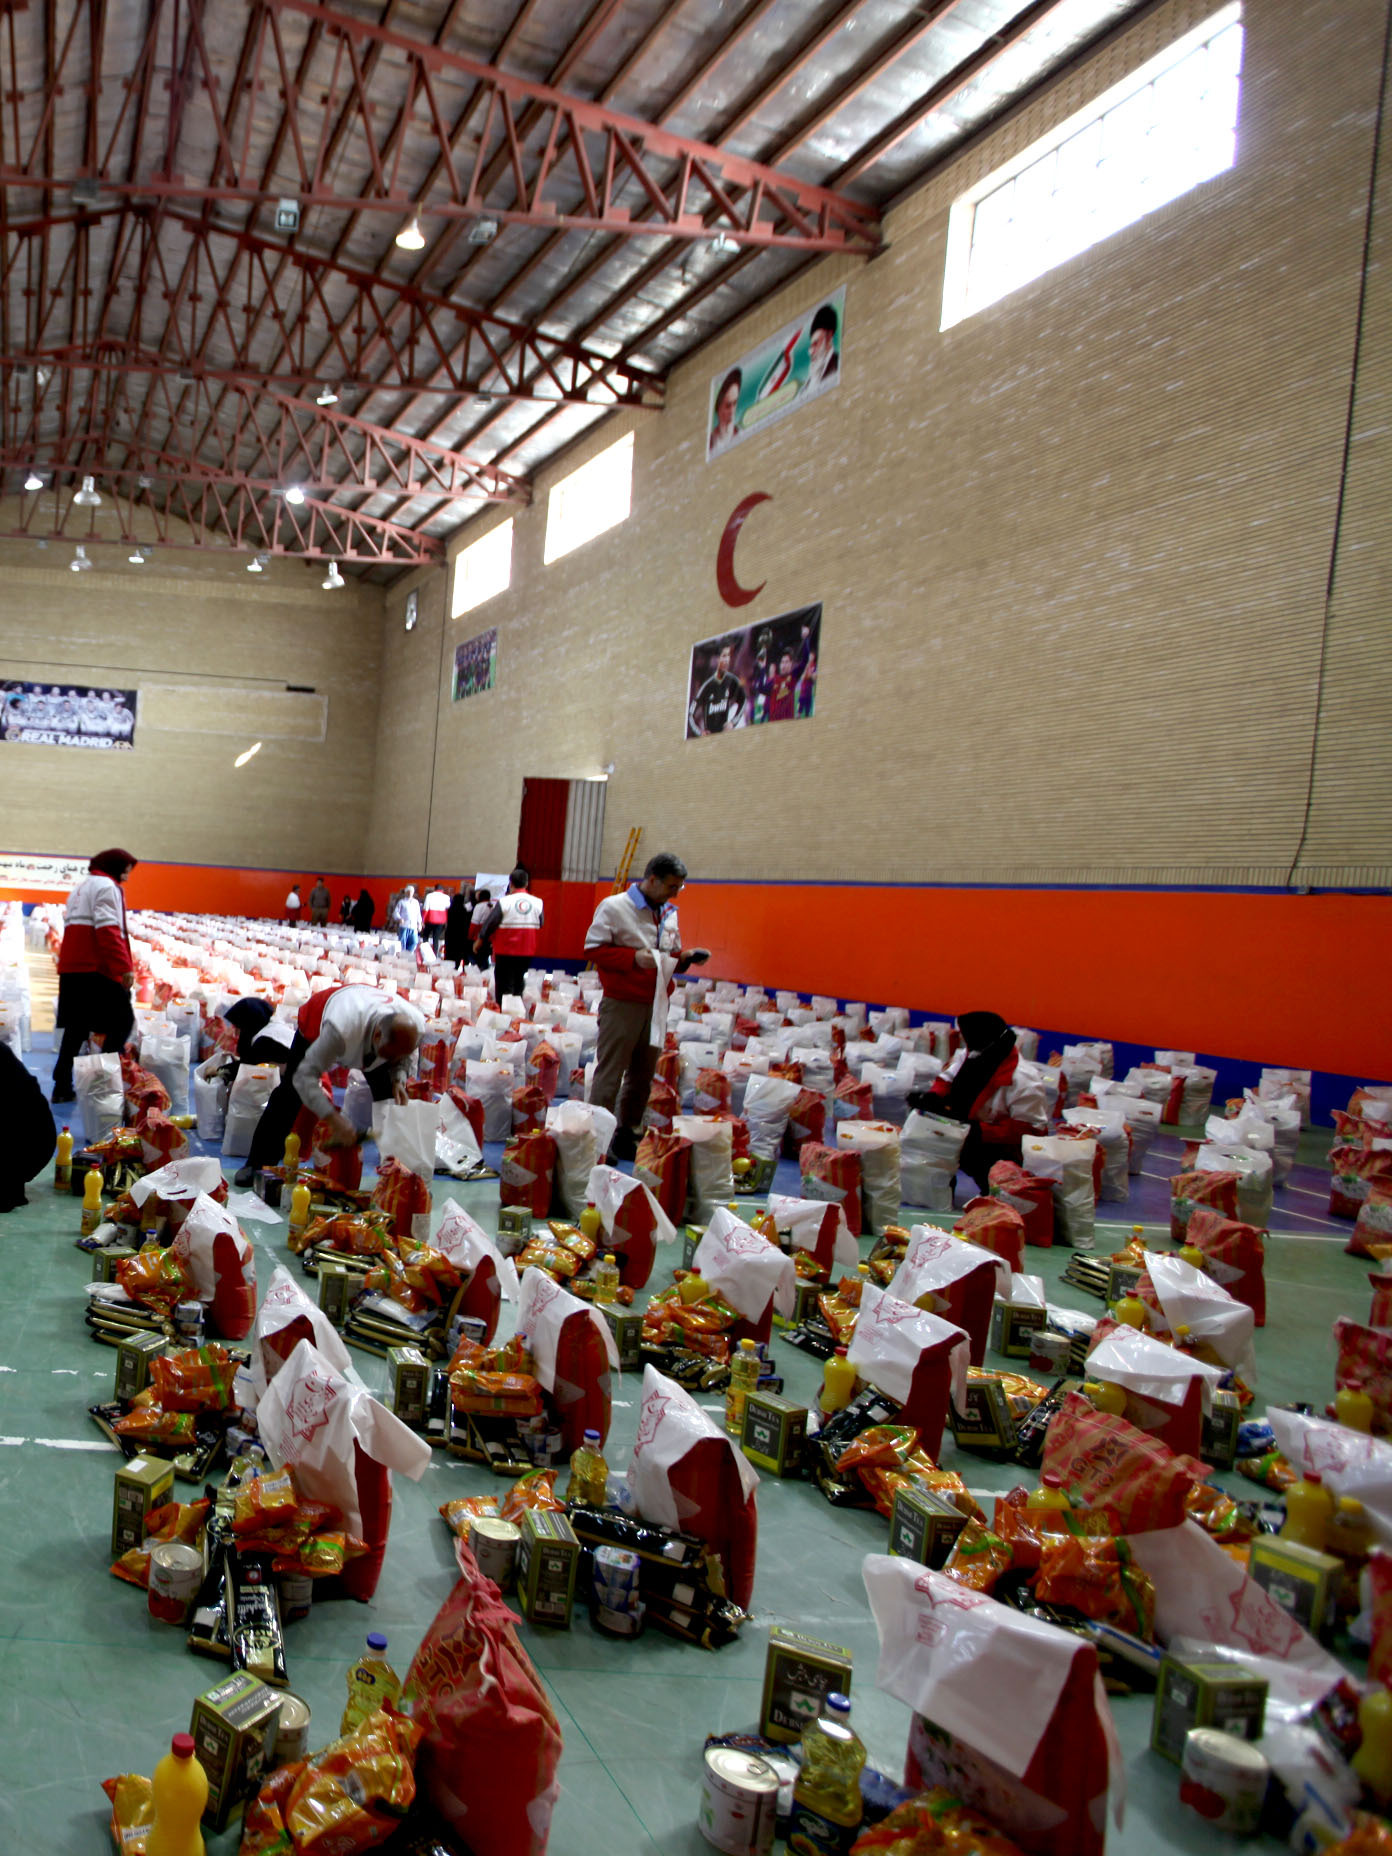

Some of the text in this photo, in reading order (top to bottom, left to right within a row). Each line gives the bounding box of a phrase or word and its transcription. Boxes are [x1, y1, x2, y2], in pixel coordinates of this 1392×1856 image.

[21, 729, 57, 744] REAL
[58, 734, 114, 748] MADRID
[1071, 1457, 1114, 1488] GTO
